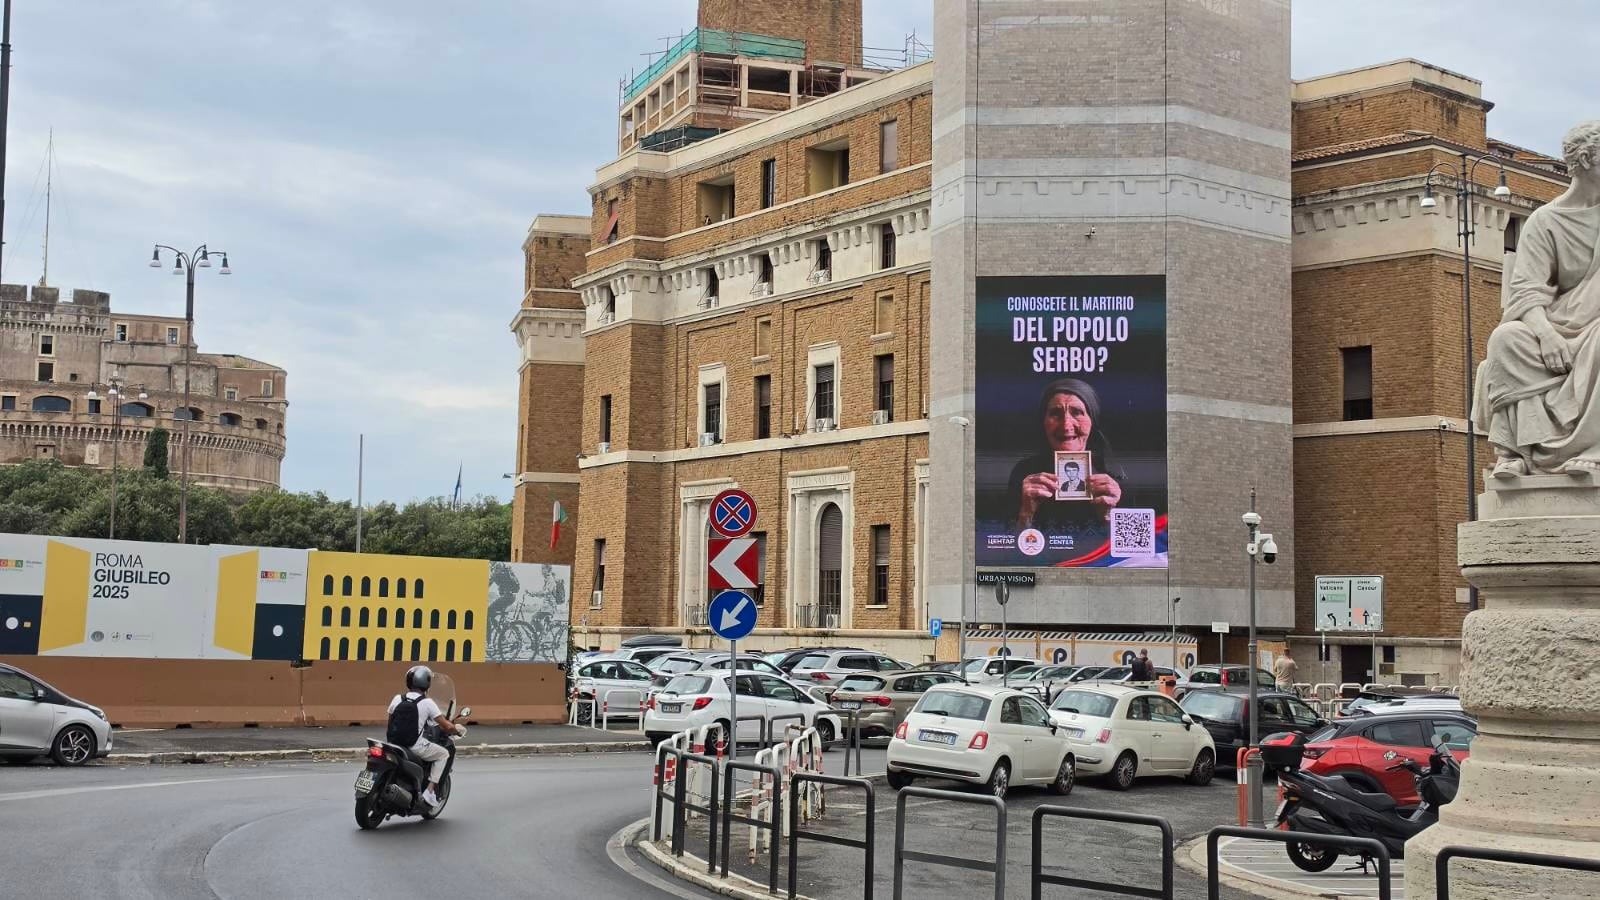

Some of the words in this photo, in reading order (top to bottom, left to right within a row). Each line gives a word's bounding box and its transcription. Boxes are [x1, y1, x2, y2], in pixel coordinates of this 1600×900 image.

[1007, 296, 1066, 312] CONOSCETE
[1069, 296, 1080, 311] IL
[1082, 295, 1134, 311] MARTIRIO
[1013, 316, 1048, 342] DEL
[1052, 316, 1129, 342] POPOLO
[1032, 346, 1109, 373] SERBO?
[95, 552, 144, 569] ROMA
[94, 568, 171, 586] GIUBILEO
[1007, 575, 1034, 583] VISION
[92, 584, 130, 599] 2025
